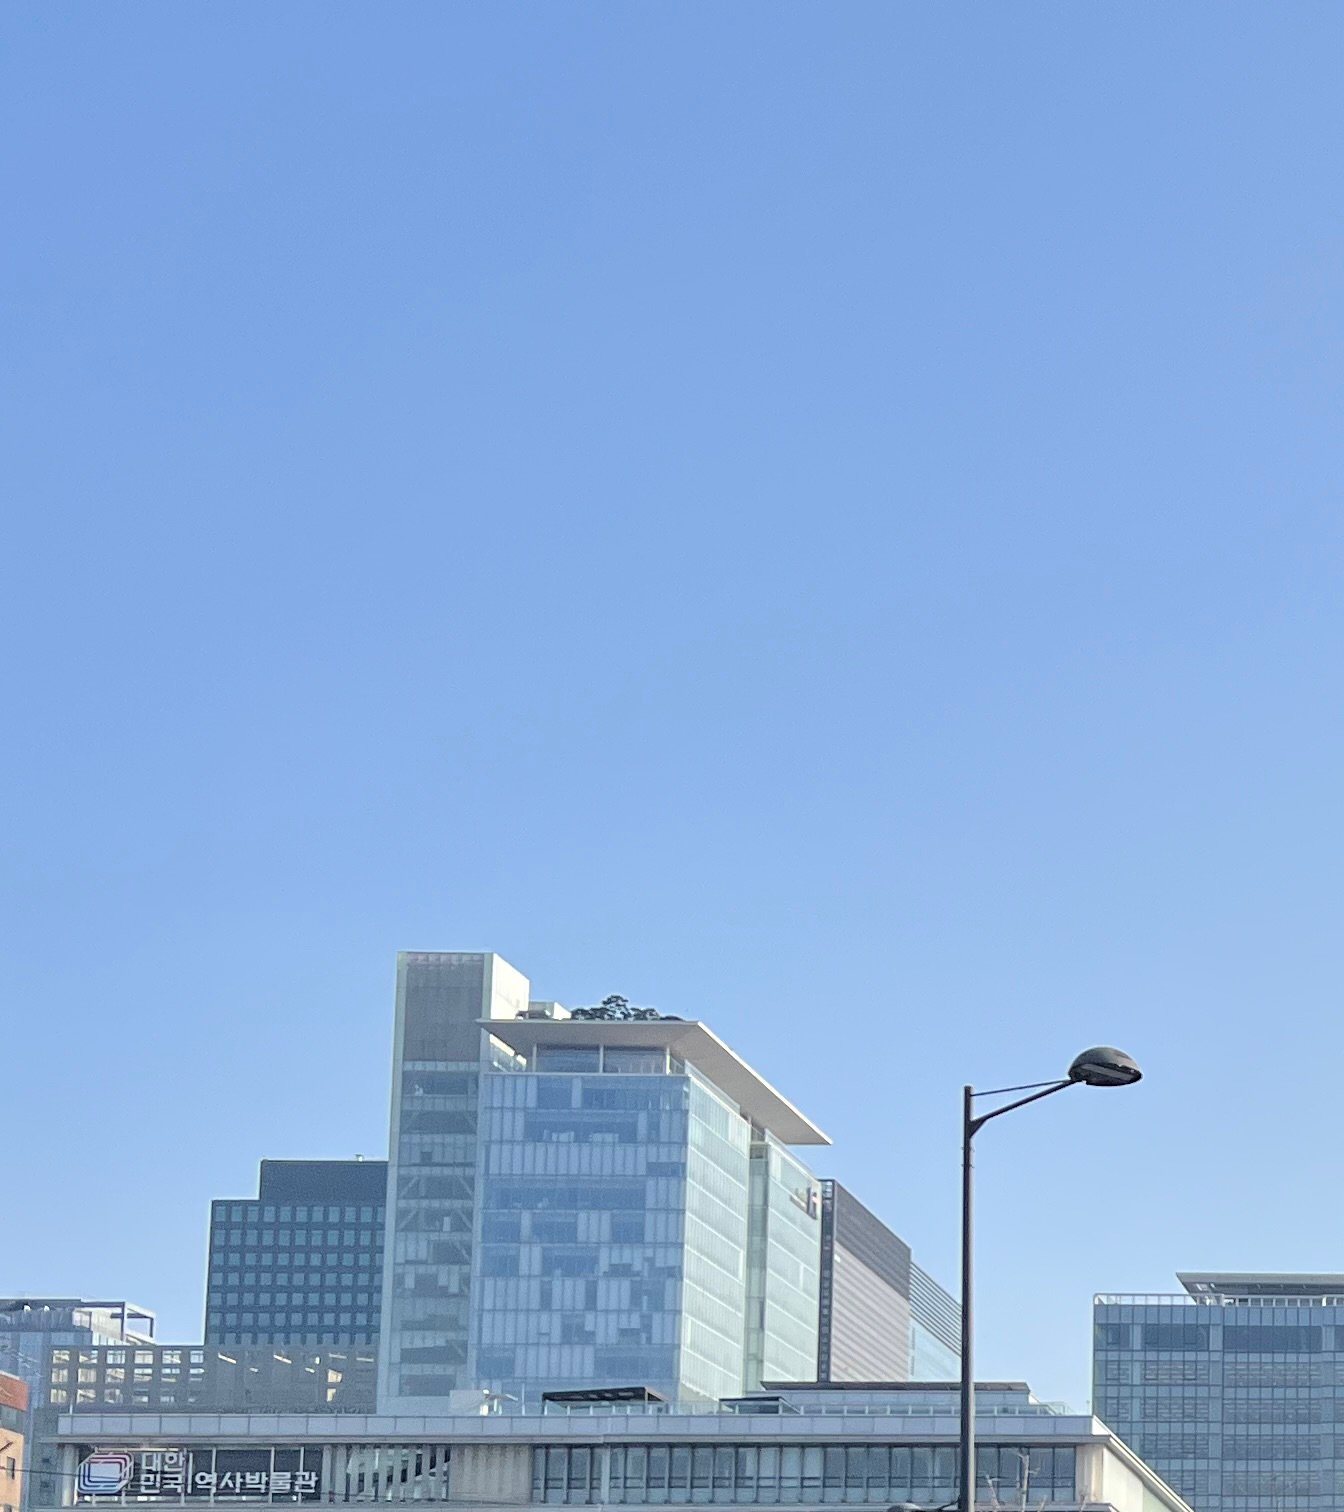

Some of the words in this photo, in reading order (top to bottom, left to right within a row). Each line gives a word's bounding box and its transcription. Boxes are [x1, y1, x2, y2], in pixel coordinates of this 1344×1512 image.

[141, 1452, 186, 1472] 대한
[140, 1473, 183, 1494] 민국
[194, 1471, 318, 1494] 역사박물관
